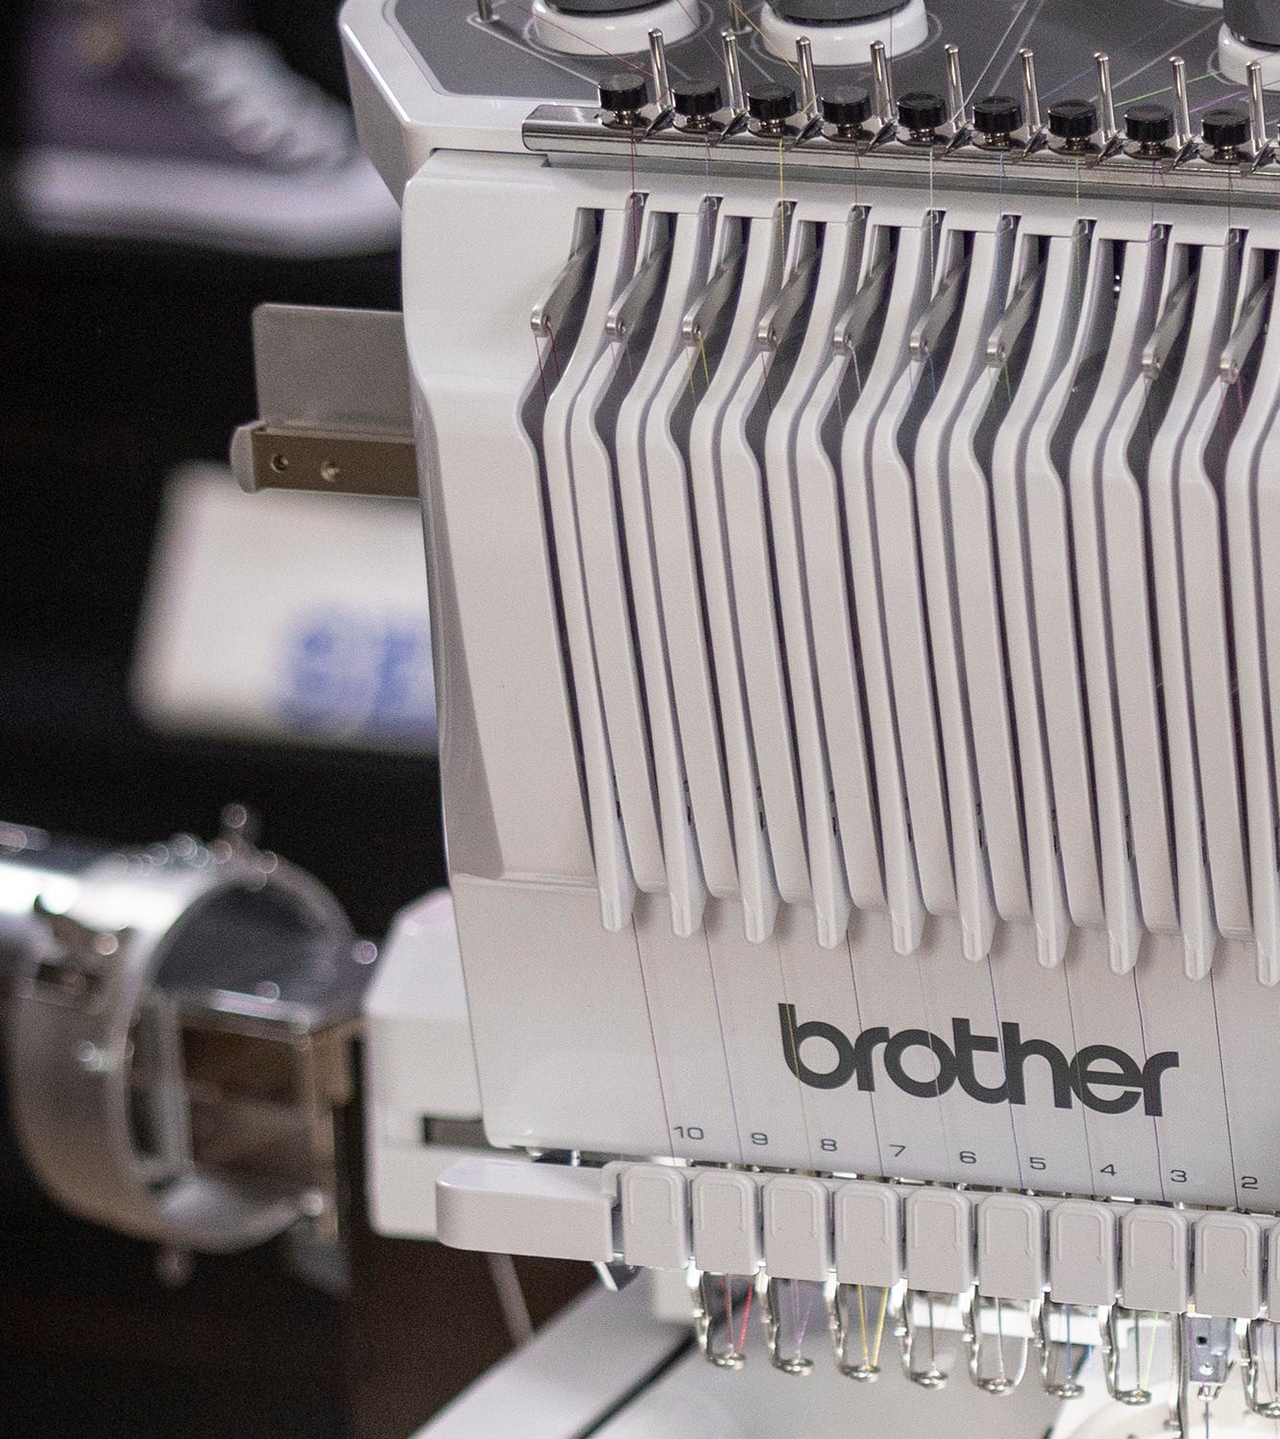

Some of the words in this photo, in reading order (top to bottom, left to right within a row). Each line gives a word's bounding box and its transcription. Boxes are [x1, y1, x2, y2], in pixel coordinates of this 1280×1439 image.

[778, 1001, 1180, 1118] brother
[674, 1125, 705, 1142] 10
[751, 1132, 768, 1147] 9
[820, 1138, 838, 1152] 8
[889, 1144, 906, 1159] 7
[959, 1150, 977, 1165] 6
[1029, 1156, 1047, 1172] 5
[1099, 1163, 1118, 1177] 4
[1170, 1169, 1188, 1184] 3
[1241, 1175, 1259, 1191] 2
